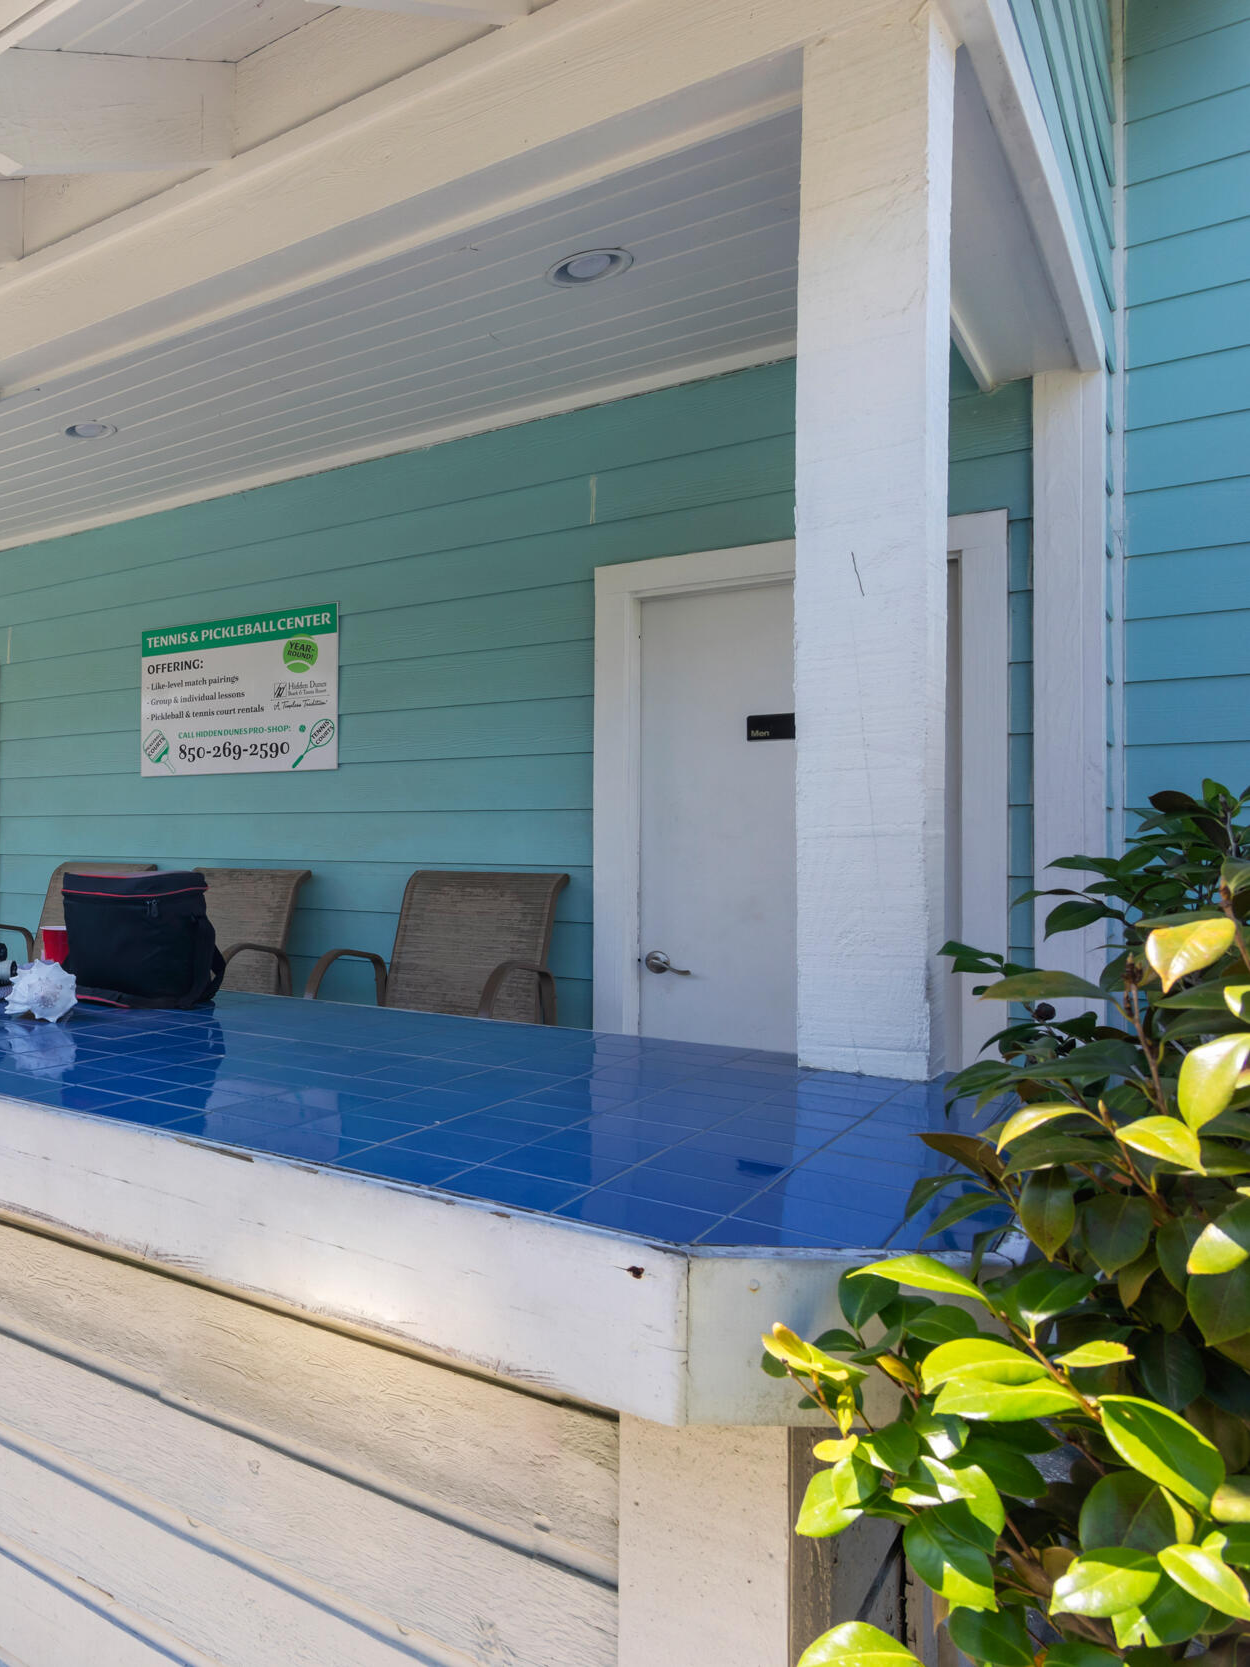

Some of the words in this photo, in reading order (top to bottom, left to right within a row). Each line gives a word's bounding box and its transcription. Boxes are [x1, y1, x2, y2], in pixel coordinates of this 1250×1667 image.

[147, 631, 188, 649] TENNIS
[189, 631, 199, 642] &
[201, 620, 276, 641] PICKLEBALL
[277, 612, 331, 631] CENTER
[287, 650, 314, 660] ROUND!
[289, 641, 315, 653] YEAR-
[147, 659, 204, 675] OFFERING:
[151, 680, 183, 691] Like-level
[185, 677, 207, 687] match
[208, 675, 239, 687] pairings
[151, 697, 172, 706] Group
[173, 696, 179, 704] &
[180, 692, 217, 703] individual
[218, 690, 245, 700] lessons
[151, 711, 184, 721] Pickleball
[185, 710, 191, 718] &
[192, 708, 215, 718] tennis
[216, 708, 236, 716] court
[237, 704, 264, 714] rentals
[178, 731, 195, 739] CALL
[196, 729, 223, 738] HIDDEN
[223, 727, 248, 736] DUNES
[311, 720, 330, 739] TENNIS
[315, 726, 334, 744] COURTS
[178, 741, 290, 763] 850-269-2590
